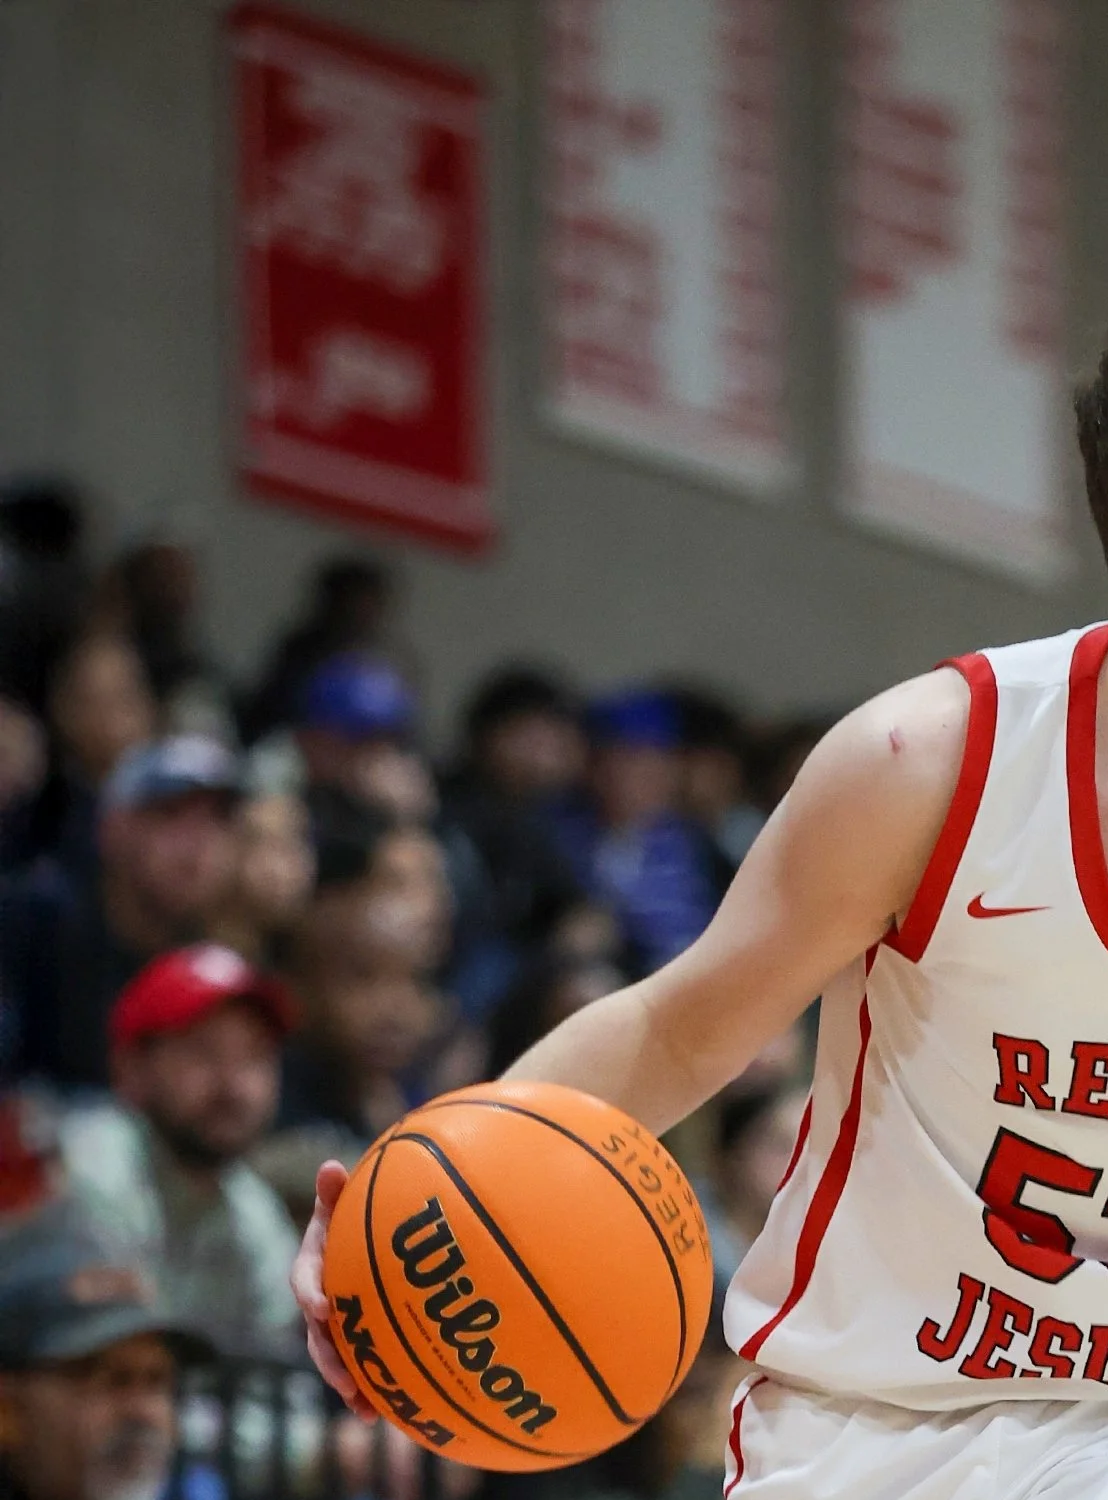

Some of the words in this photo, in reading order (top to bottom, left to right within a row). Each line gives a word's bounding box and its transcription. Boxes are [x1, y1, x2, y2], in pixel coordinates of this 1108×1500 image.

[600, 1132, 695, 1256] REGIS
[335, 1294, 456, 1447] NCAA
[391, 1196, 558, 1435] Wilson
